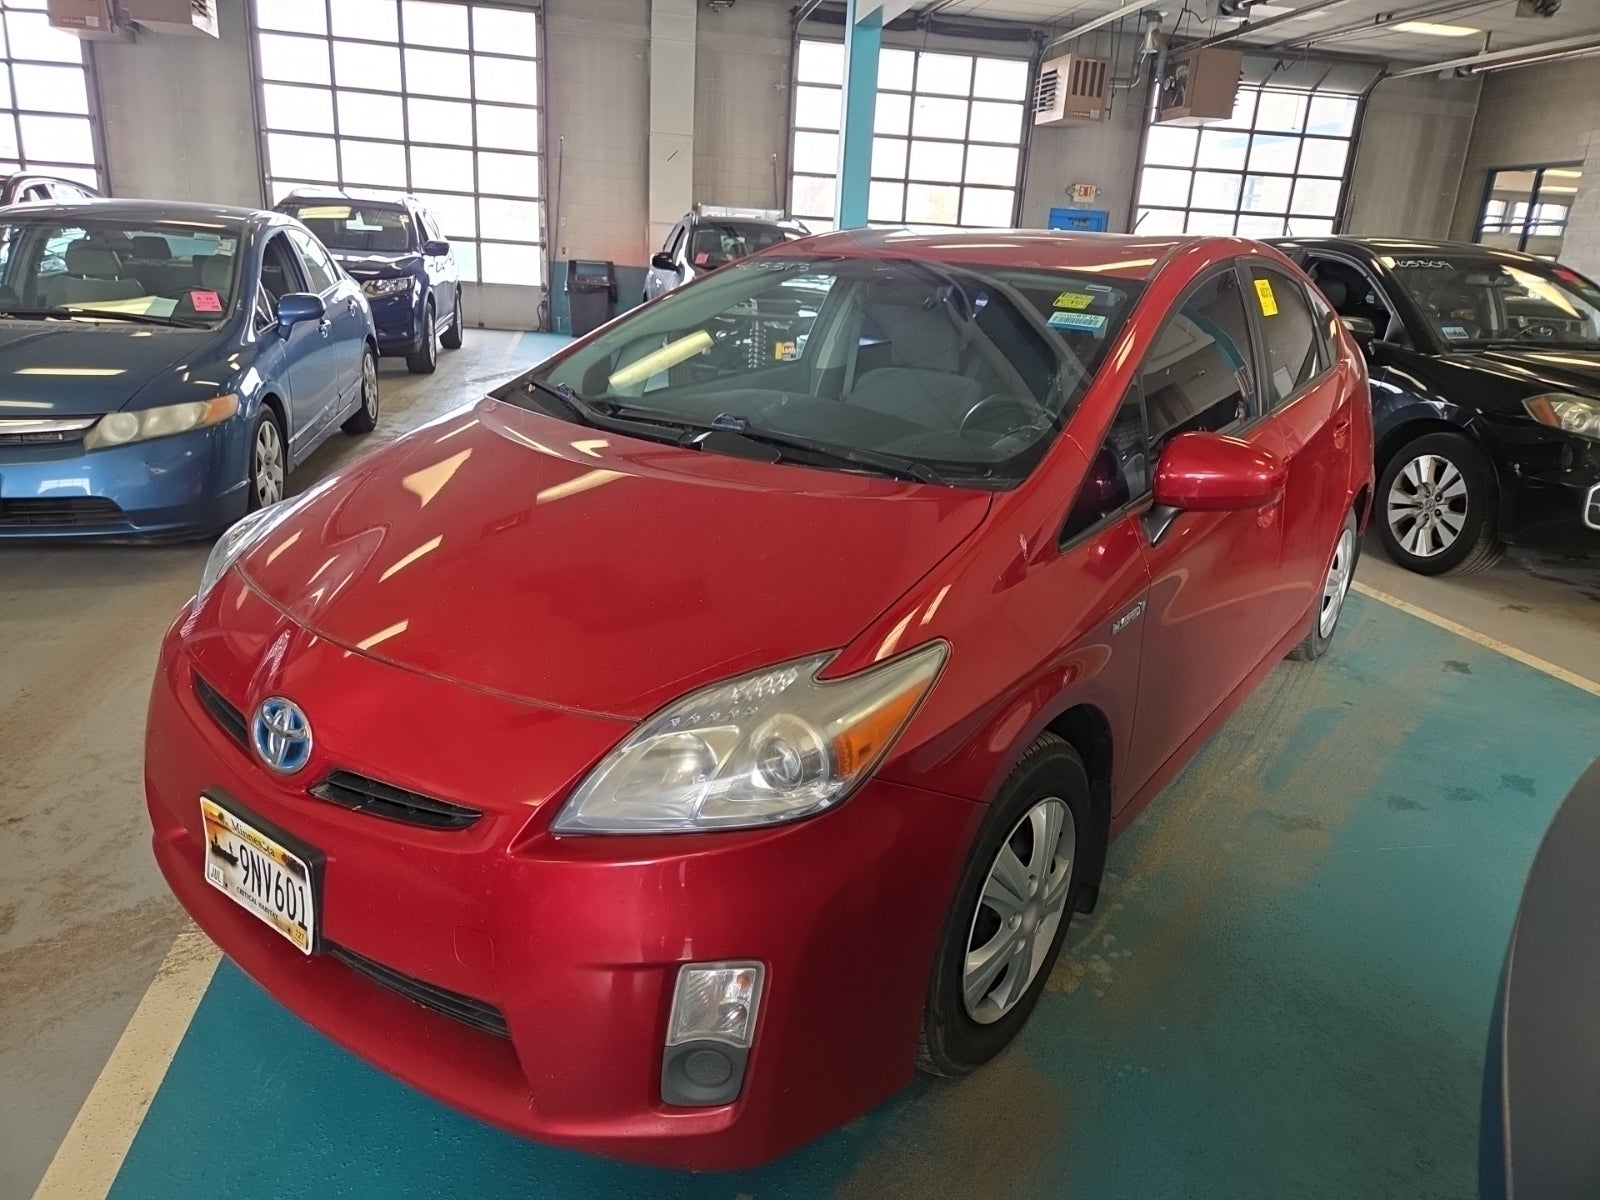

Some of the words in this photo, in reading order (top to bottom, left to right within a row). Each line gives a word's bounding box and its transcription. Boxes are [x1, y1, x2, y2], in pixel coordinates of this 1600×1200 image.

[1078, 185, 1093, 198] EXIT
[230, 818, 276, 858] Minnesota
[236, 886, 258, 905] CRITICAL
[258, 902, 279, 920] HABITAT
[239, 844, 308, 932] 9NV601
